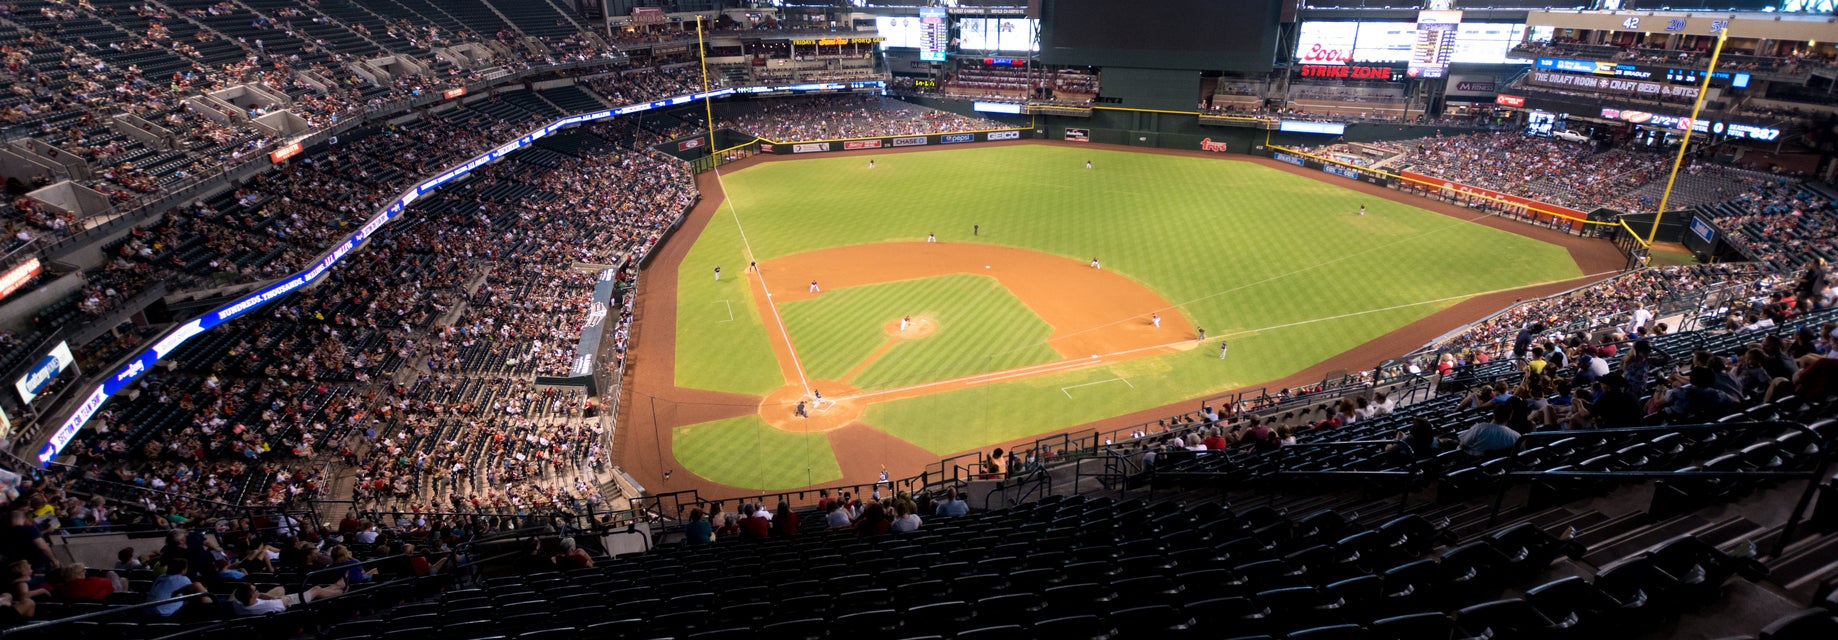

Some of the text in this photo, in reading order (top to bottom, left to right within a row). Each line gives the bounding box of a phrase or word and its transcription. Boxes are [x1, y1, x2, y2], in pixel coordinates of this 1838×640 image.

[1622, 16, 1640, 29] 42
[1666, 18, 1686, 31] 20
[1304, 43, 1353, 62] Coors
[1301, 65, 1349, 78] STRIKE
[1350, 66, 1392, 79] ZONE
[1535, 73, 1700, 98] THE DRAFT ROOM CRAFT BEER & BITES
[1713, 122, 1724, 134] 0
[952, 134, 970, 143] pepsi
[989, 131, 1018, 139] GEICO
